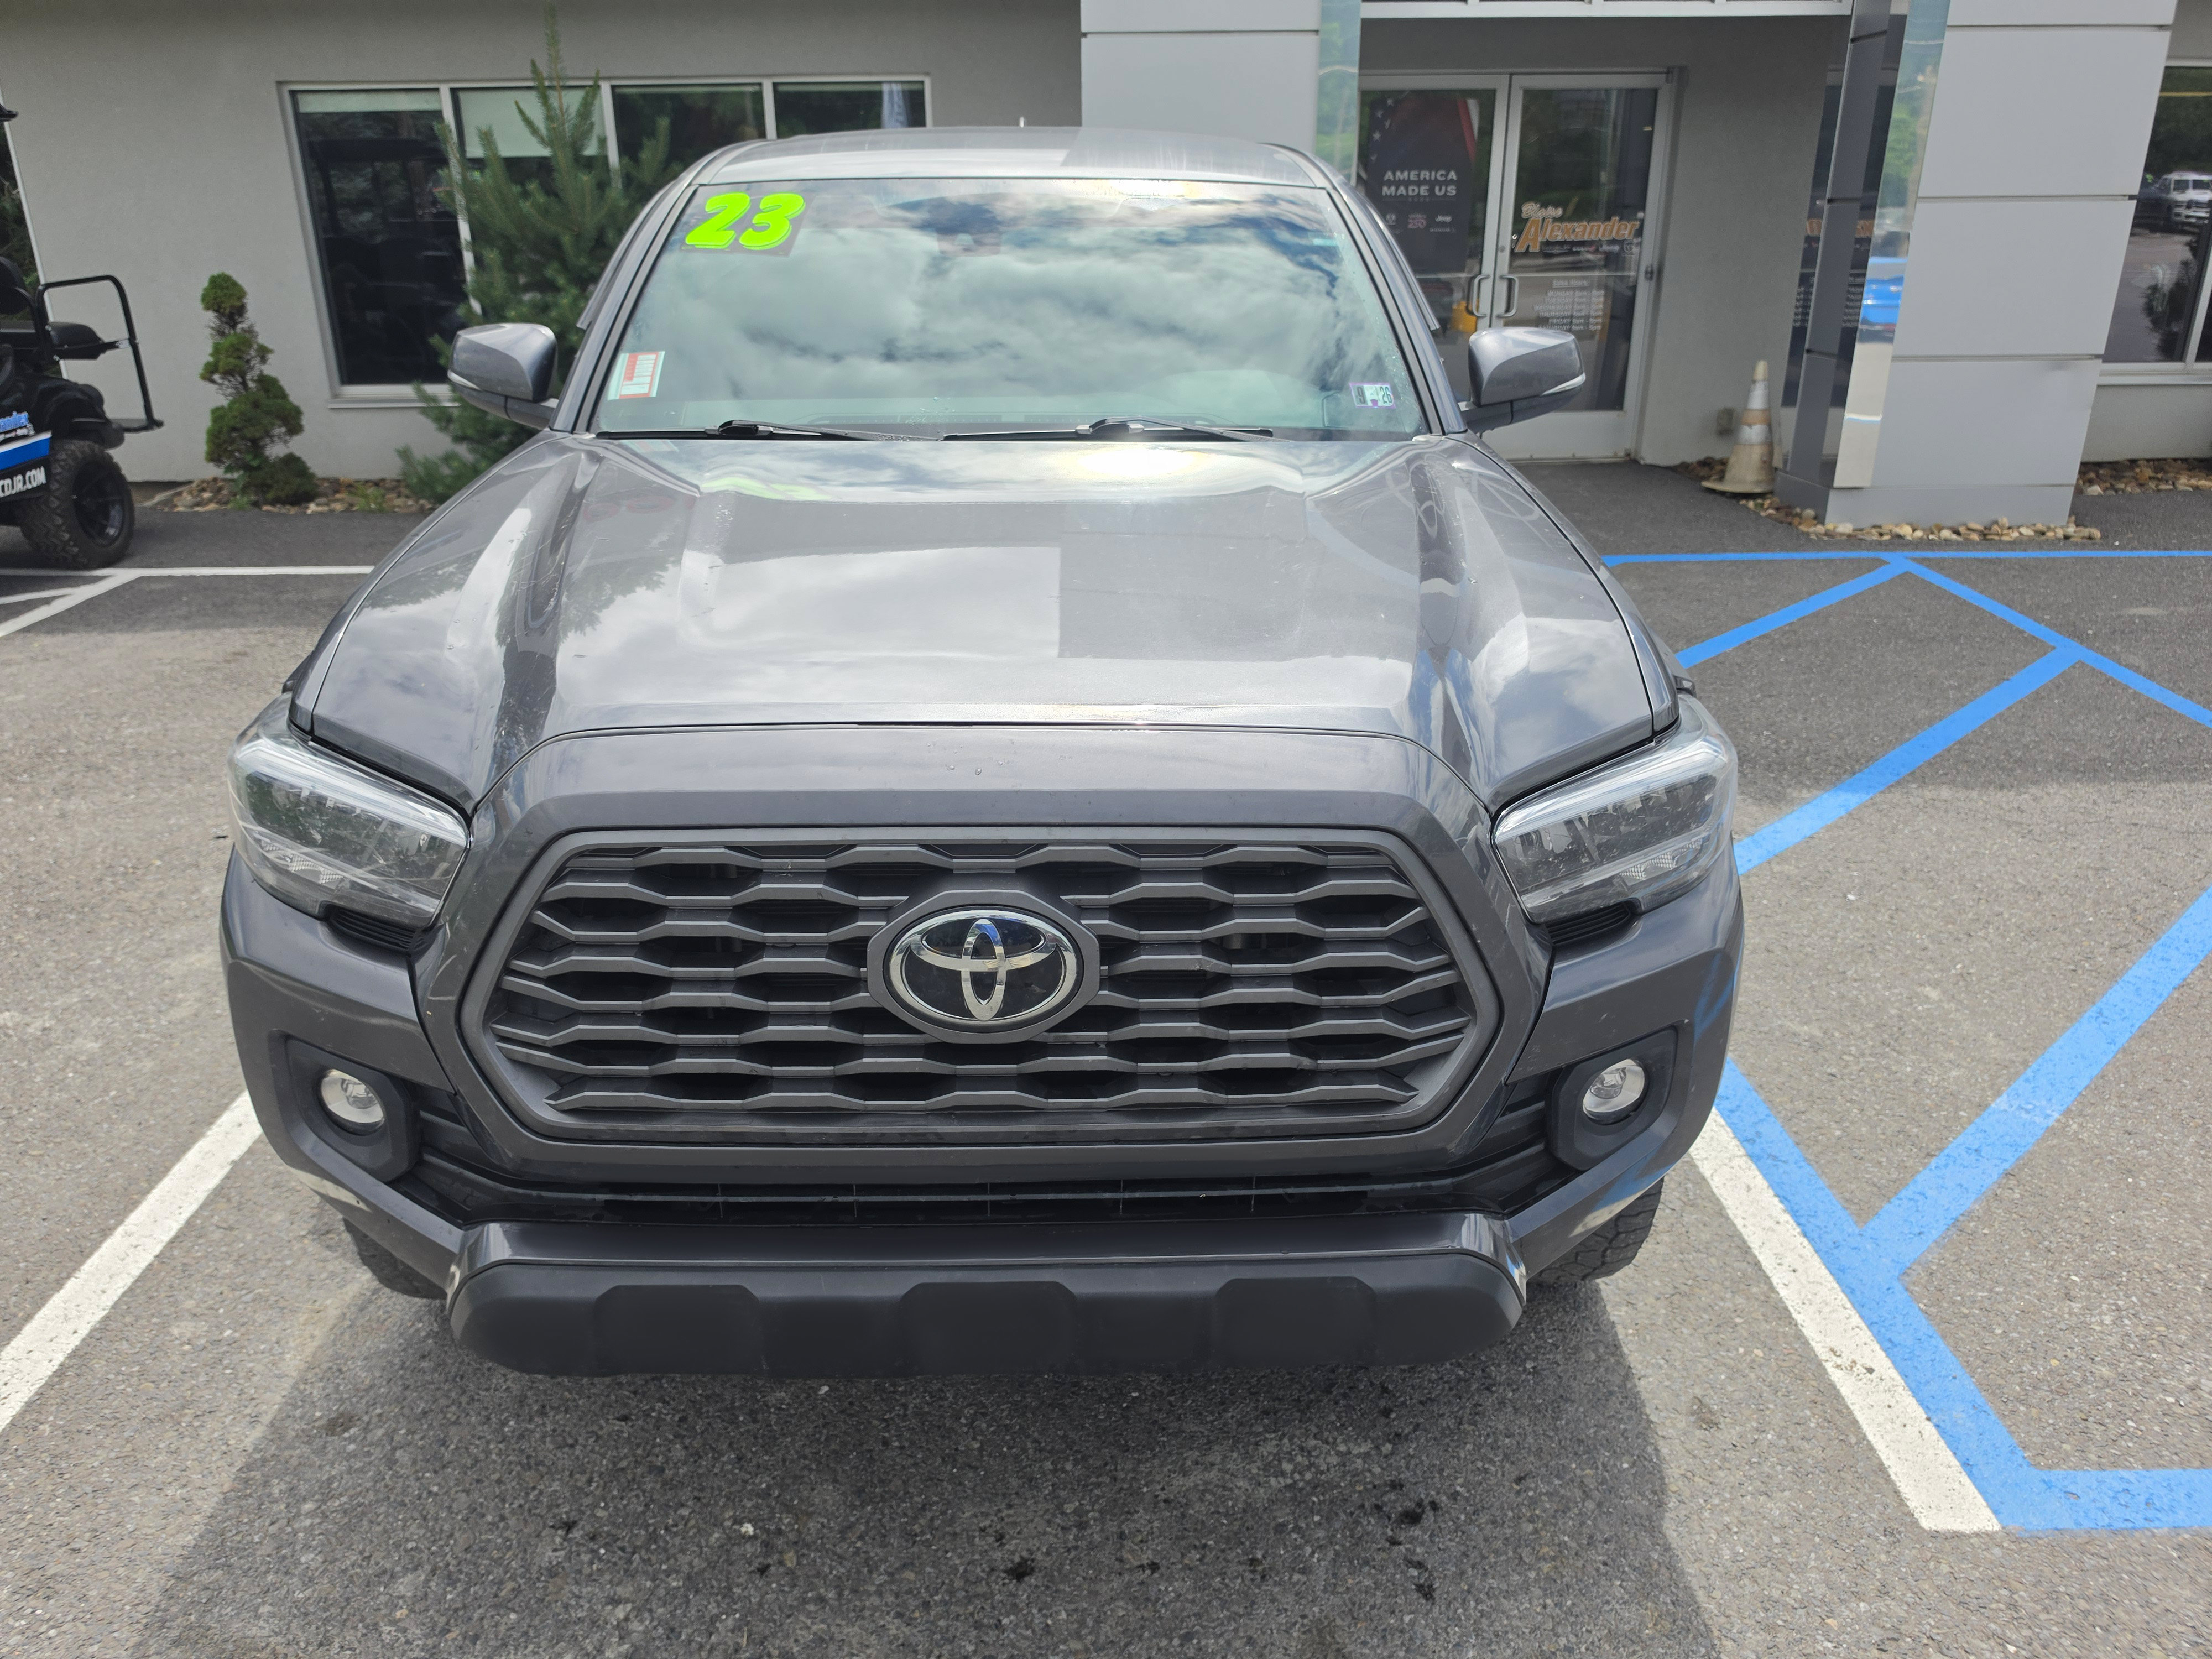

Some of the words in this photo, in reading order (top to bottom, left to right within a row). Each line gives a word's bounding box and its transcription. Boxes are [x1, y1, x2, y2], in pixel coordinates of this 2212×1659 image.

[1384, 170, 1457, 181] AMERICA
[1382, 185, 1430, 196] MADE
[1434, 185, 1457, 196] US
[686, 192, 806, 250] 23
[1514, 215, 1641, 253] Alexander
[1357, 387, 1366, 404] 9
[1380, 386, 1392, 404] 26
